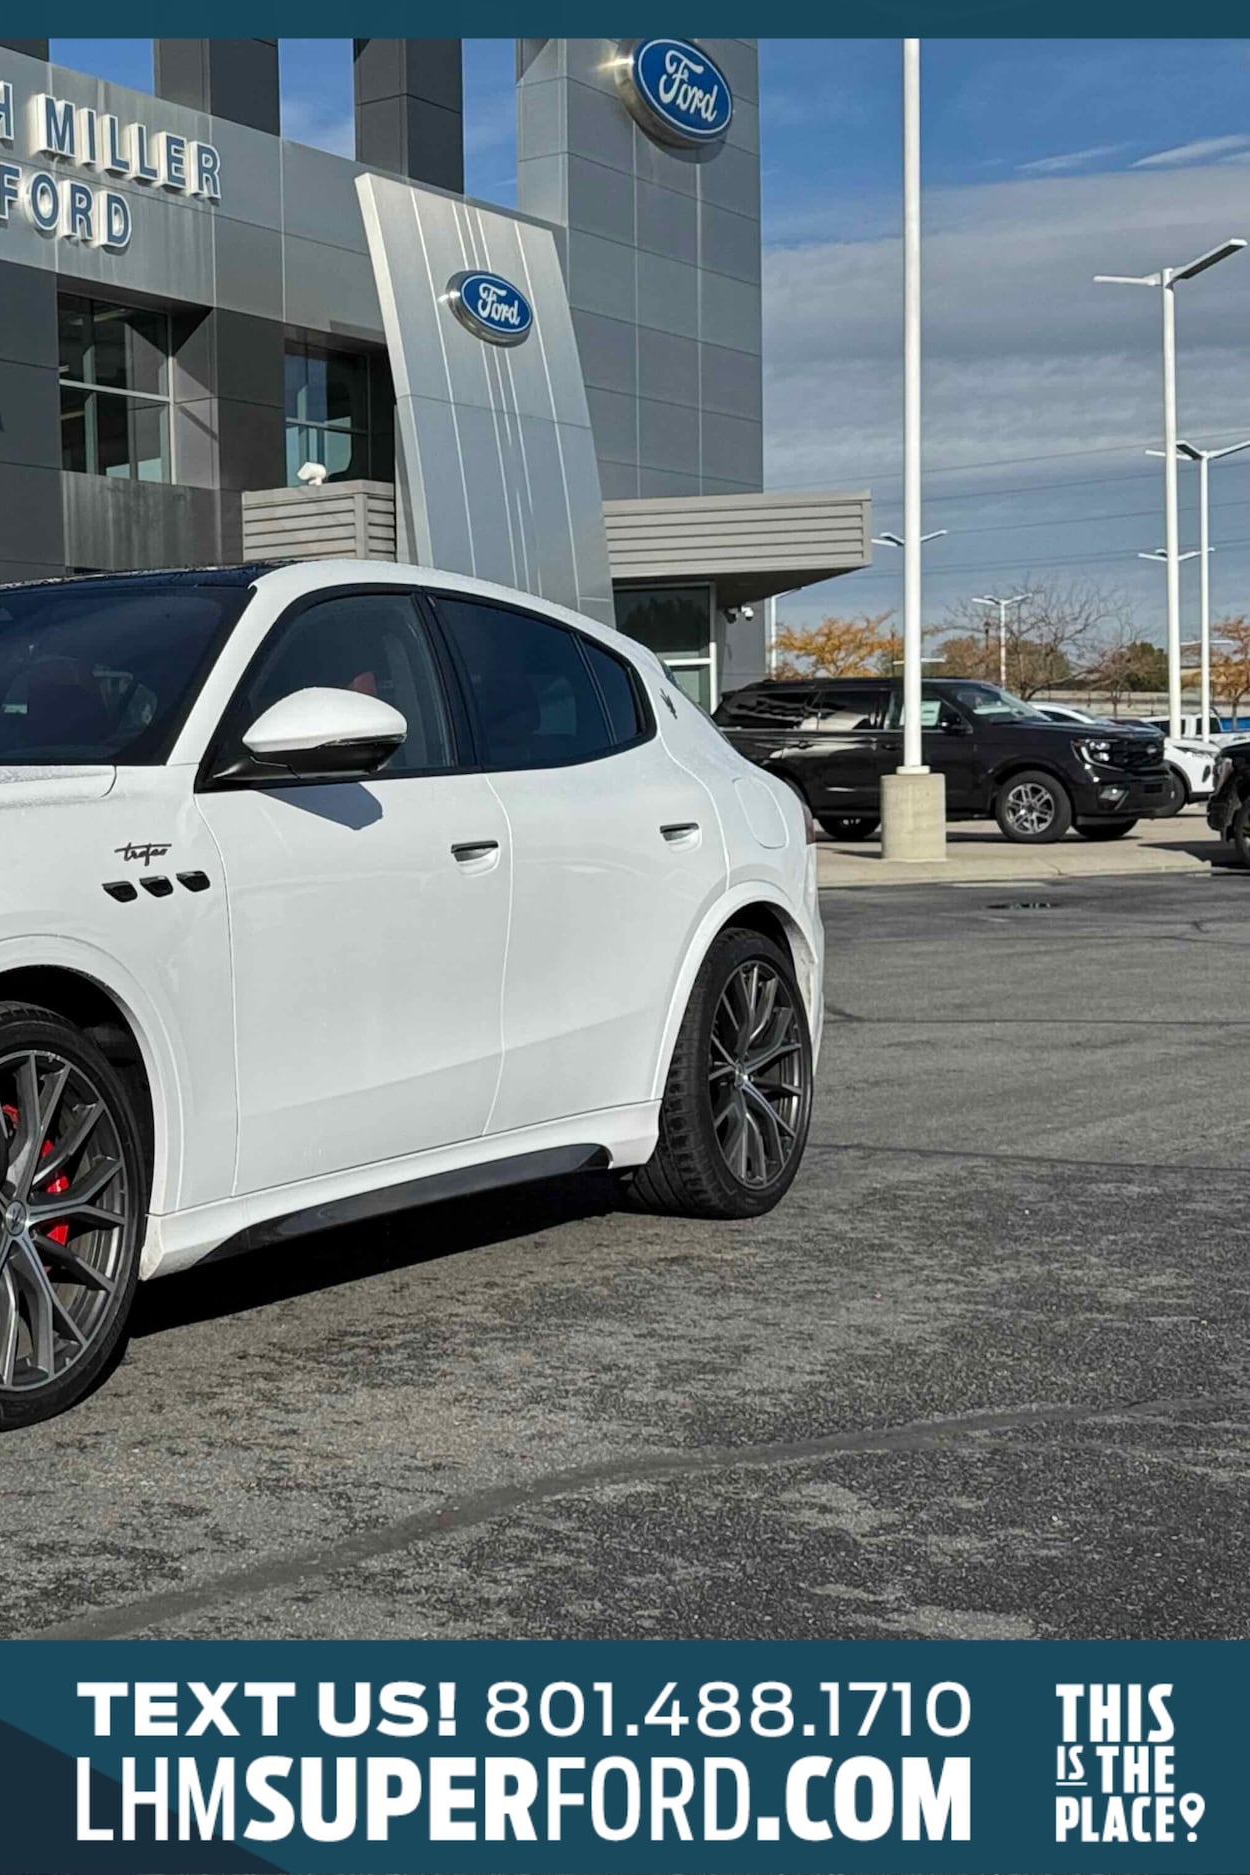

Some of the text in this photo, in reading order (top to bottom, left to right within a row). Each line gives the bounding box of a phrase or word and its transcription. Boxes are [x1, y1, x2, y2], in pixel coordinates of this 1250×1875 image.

[658, 49, 718, 122] Ford
[39, 93, 221, 200] MILLER
[477, 282, 520, 326] Ford
